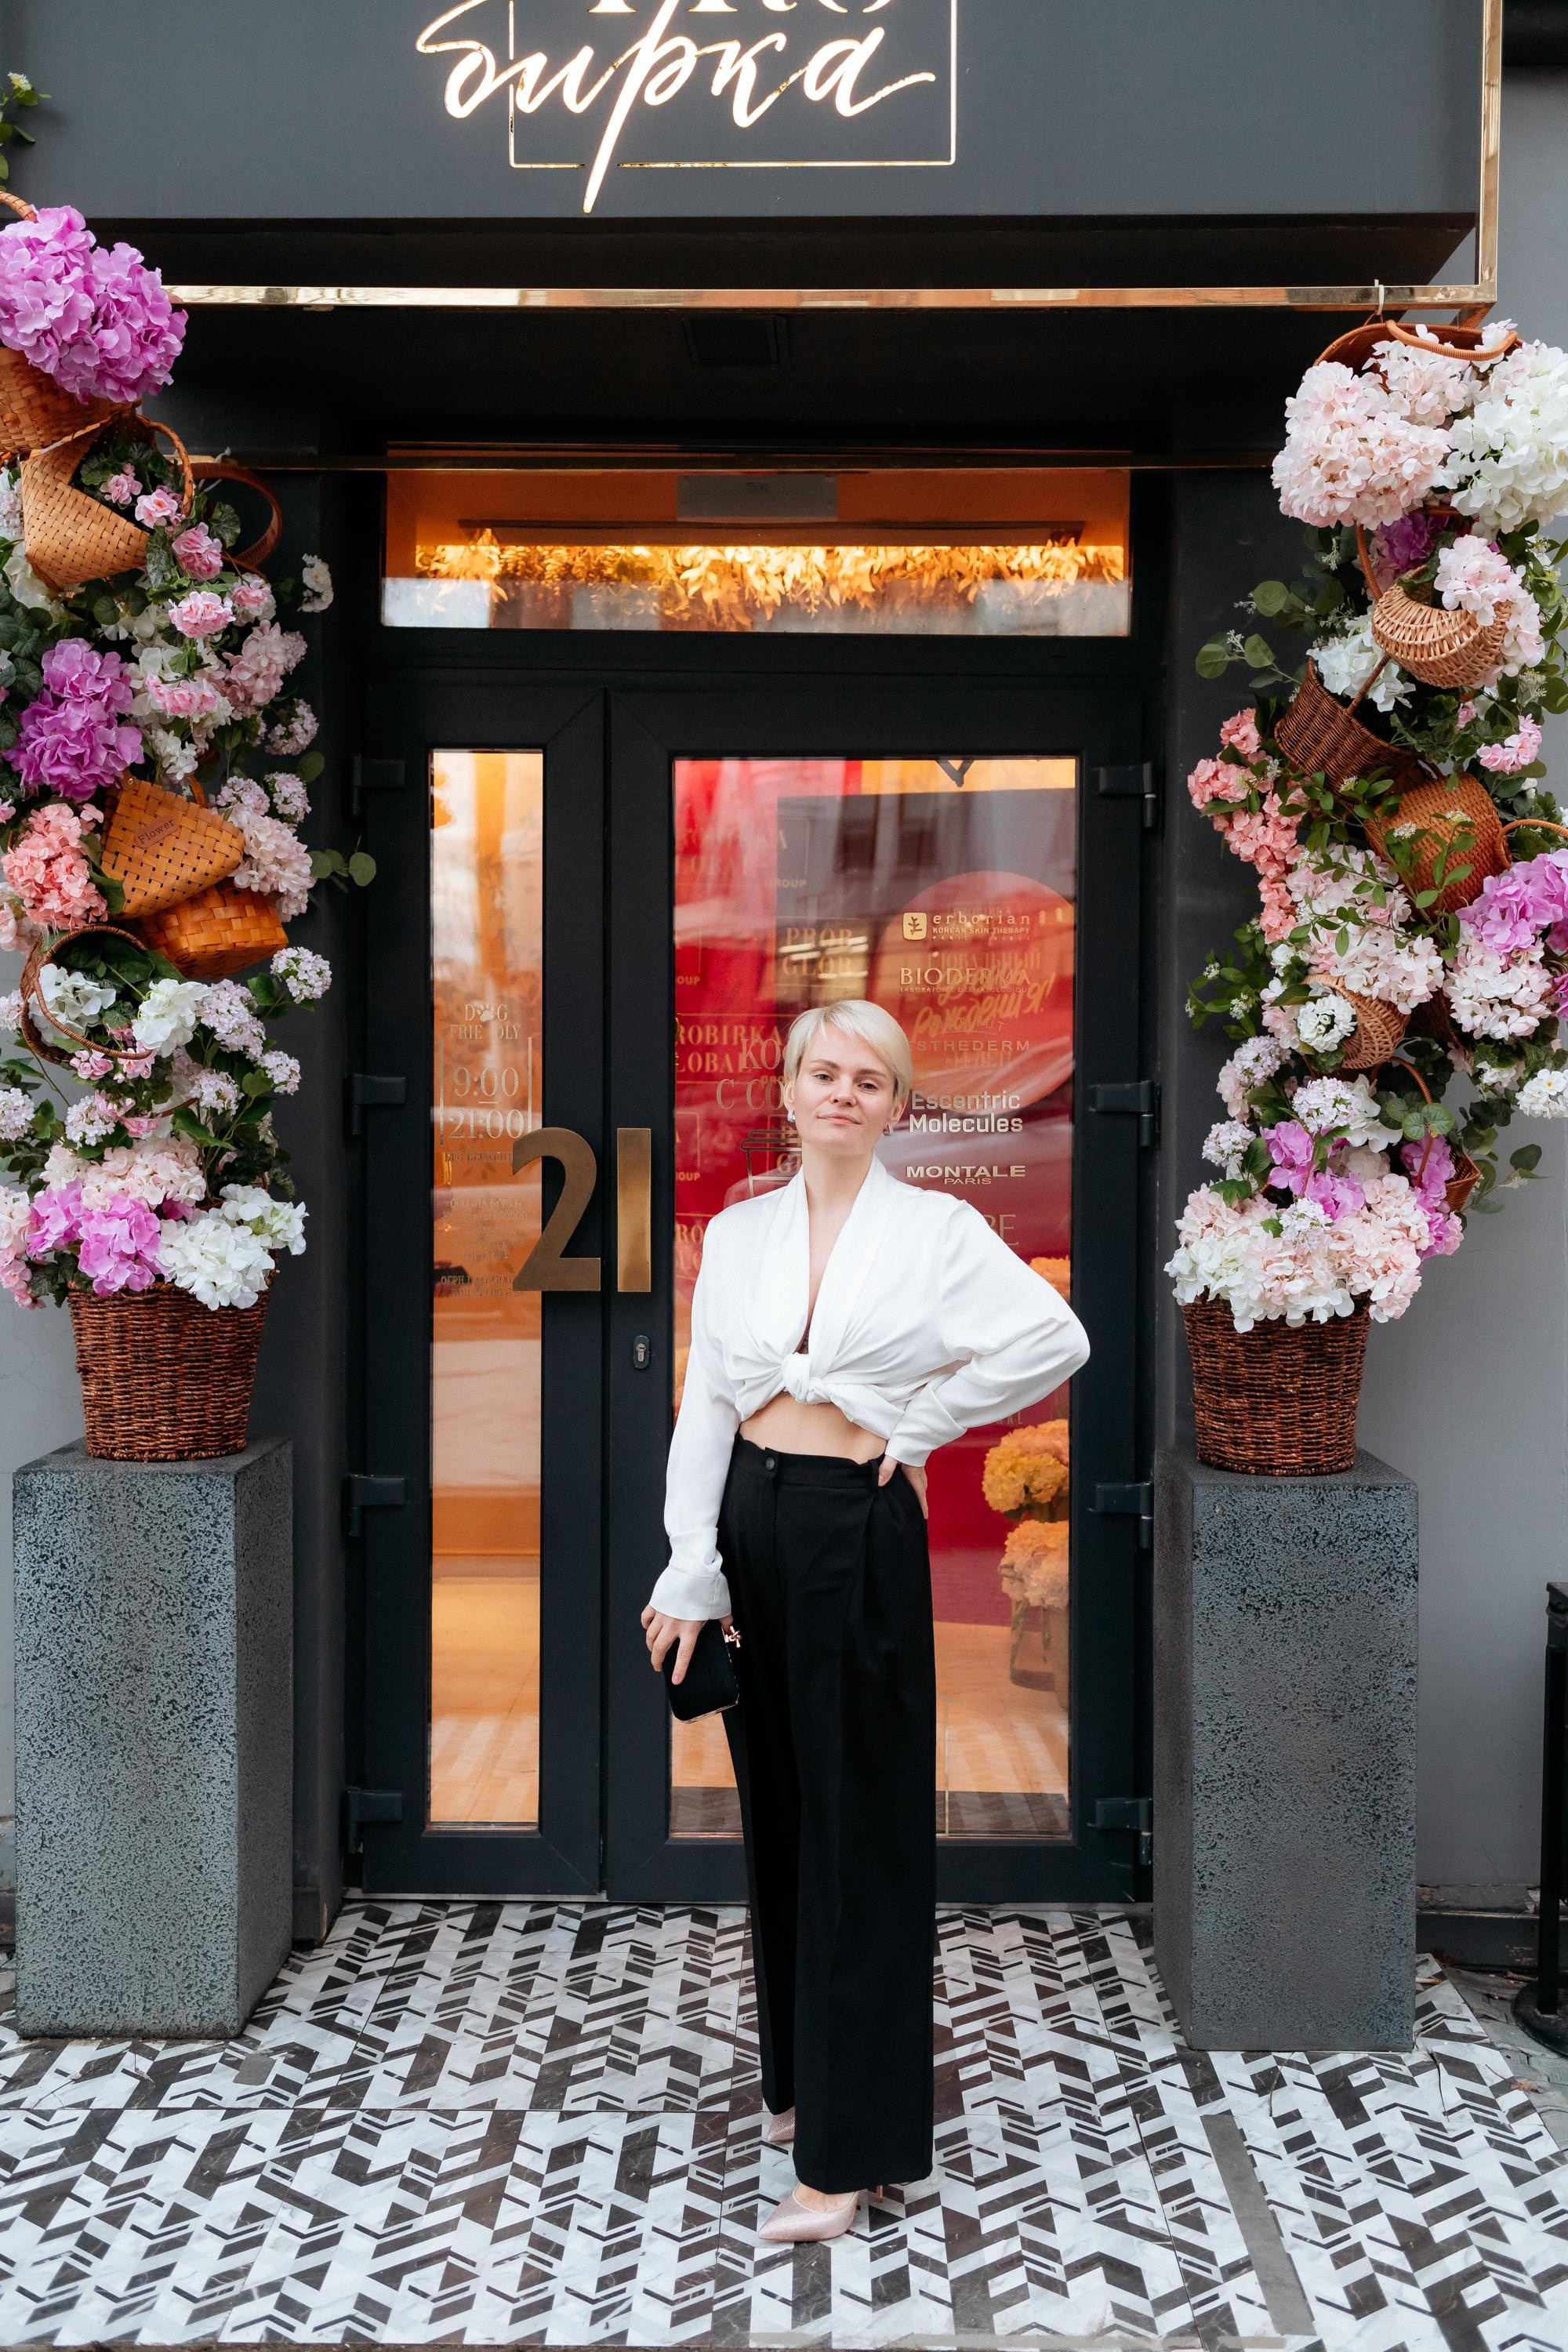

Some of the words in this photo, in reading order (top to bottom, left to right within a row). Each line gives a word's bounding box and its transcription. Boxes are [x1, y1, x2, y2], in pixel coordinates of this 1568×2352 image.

[138, 819, 174, 844] Flower
[932, 910, 1031, 924] erborian
[899, 967, 1031, 985] BIODERMA
[465, 1004, 508, 1022] DG
[449, 1024, 522, 1040] FRIEDLY
[452, 1066, 520, 1097] 9:00
[912, 1090, 1021, 1110] Escentric
[448, 1109, 524, 1139] 21:00
[909, 1112, 1023, 1133] Molecules
[906, 1165, 1025, 1178] MONTALE
